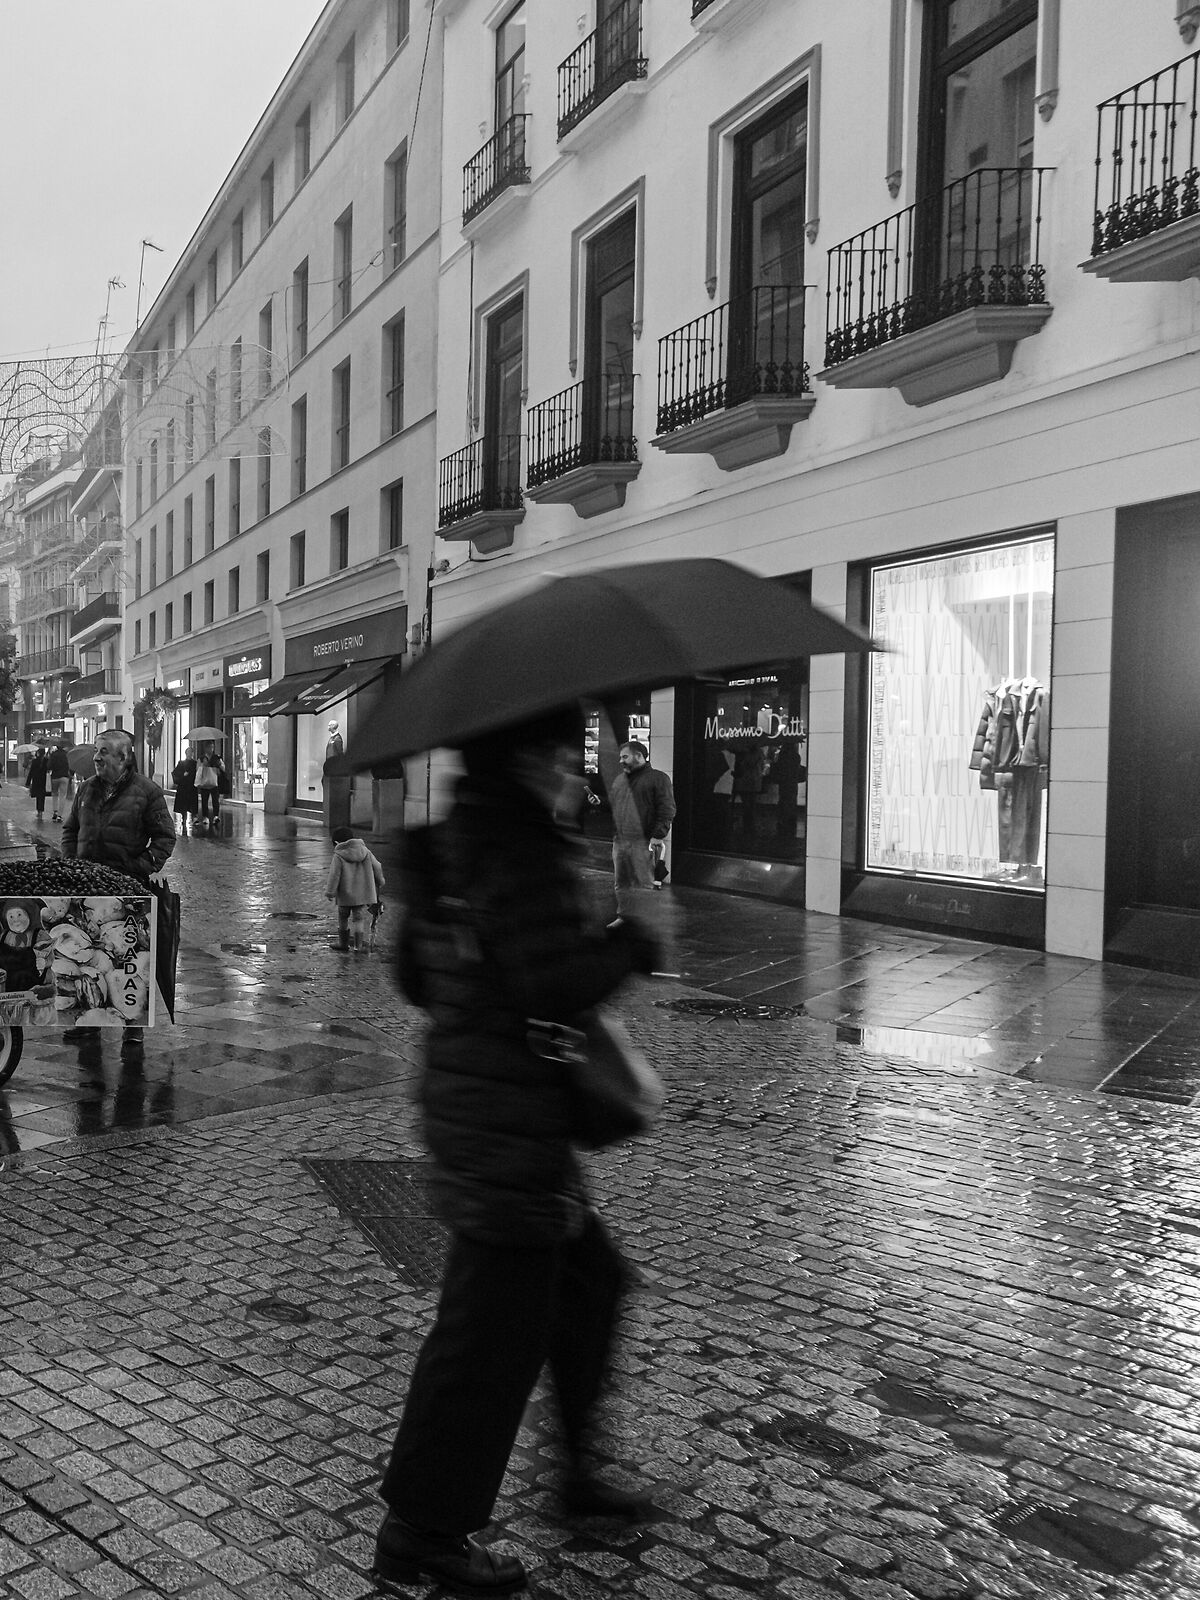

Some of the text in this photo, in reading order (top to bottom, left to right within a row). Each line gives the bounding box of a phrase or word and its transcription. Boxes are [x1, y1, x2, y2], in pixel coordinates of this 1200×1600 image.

[313, 634, 364, 657] ROBERTO VERINO
[704, 713, 806, 740] Massimo Dutti
[123, 915, 138, 1006] ASADAS
